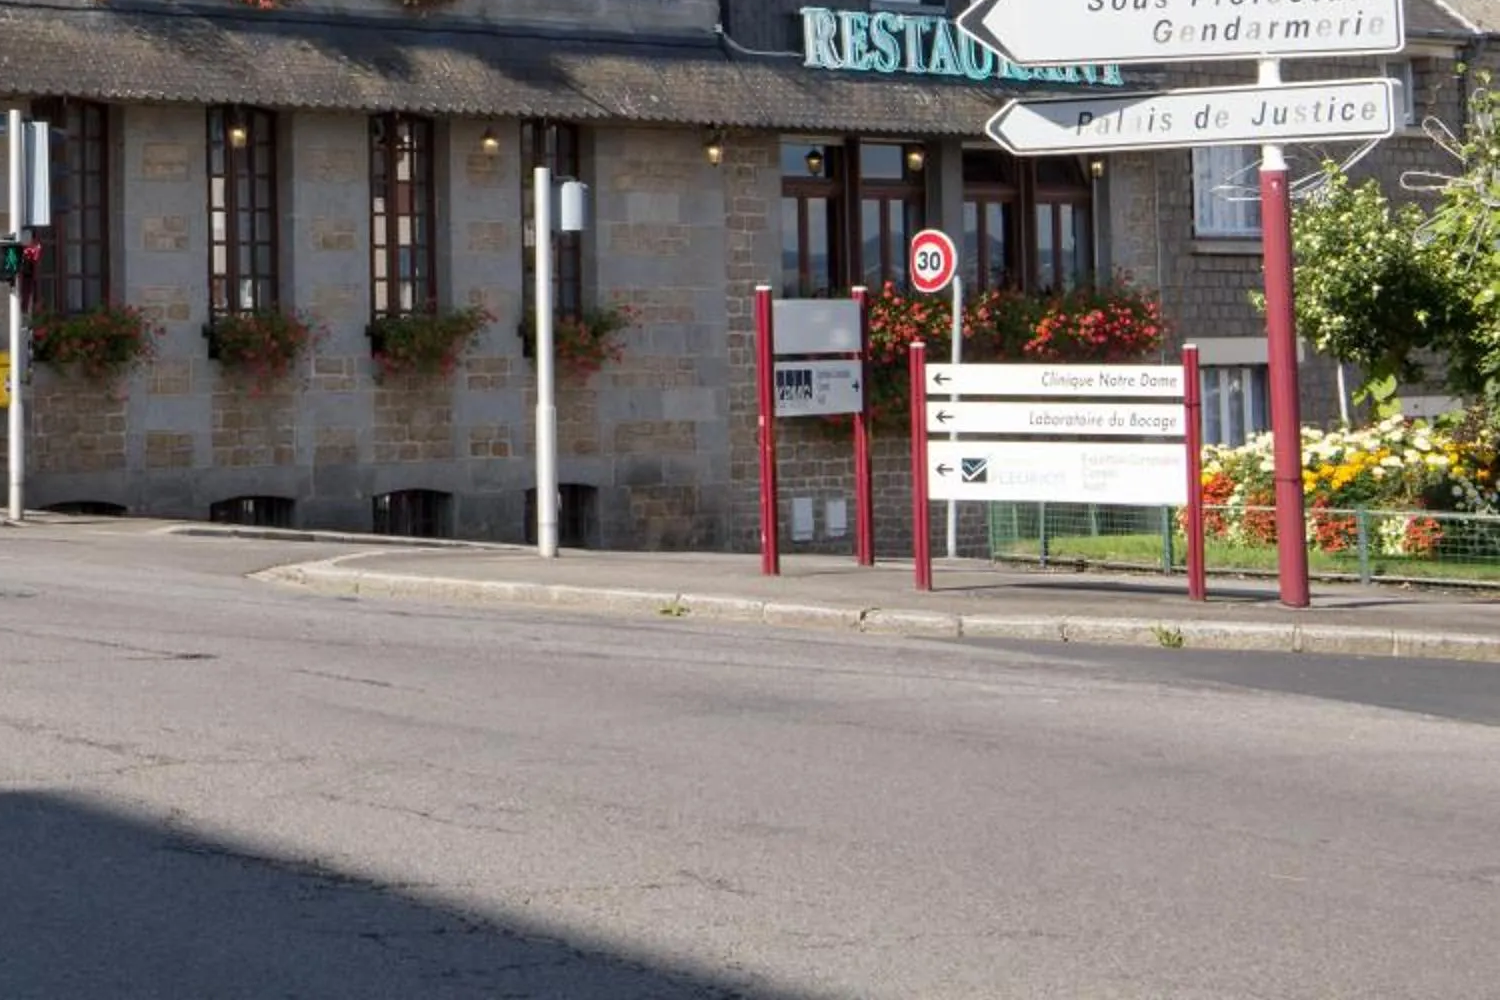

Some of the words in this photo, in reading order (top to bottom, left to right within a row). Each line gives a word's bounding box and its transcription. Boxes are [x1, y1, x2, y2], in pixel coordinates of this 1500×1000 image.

[1153, 10, 1385, 44] Gendarmerie
[1195, 104, 1230, 130] de
[1251, 96, 1378, 127] Justice
[917, 251, 941, 271] 30
[1041, 371, 1094, 390] Clinique
[1099, 372, 1135, 387] Notre
[1140, 372, 1177, 388] Dame
[1029, 411, 1103, 427] Laboratoire
[1108, 412, 1125, 427] du
[1130, 413, 1177, 431] Bocage
